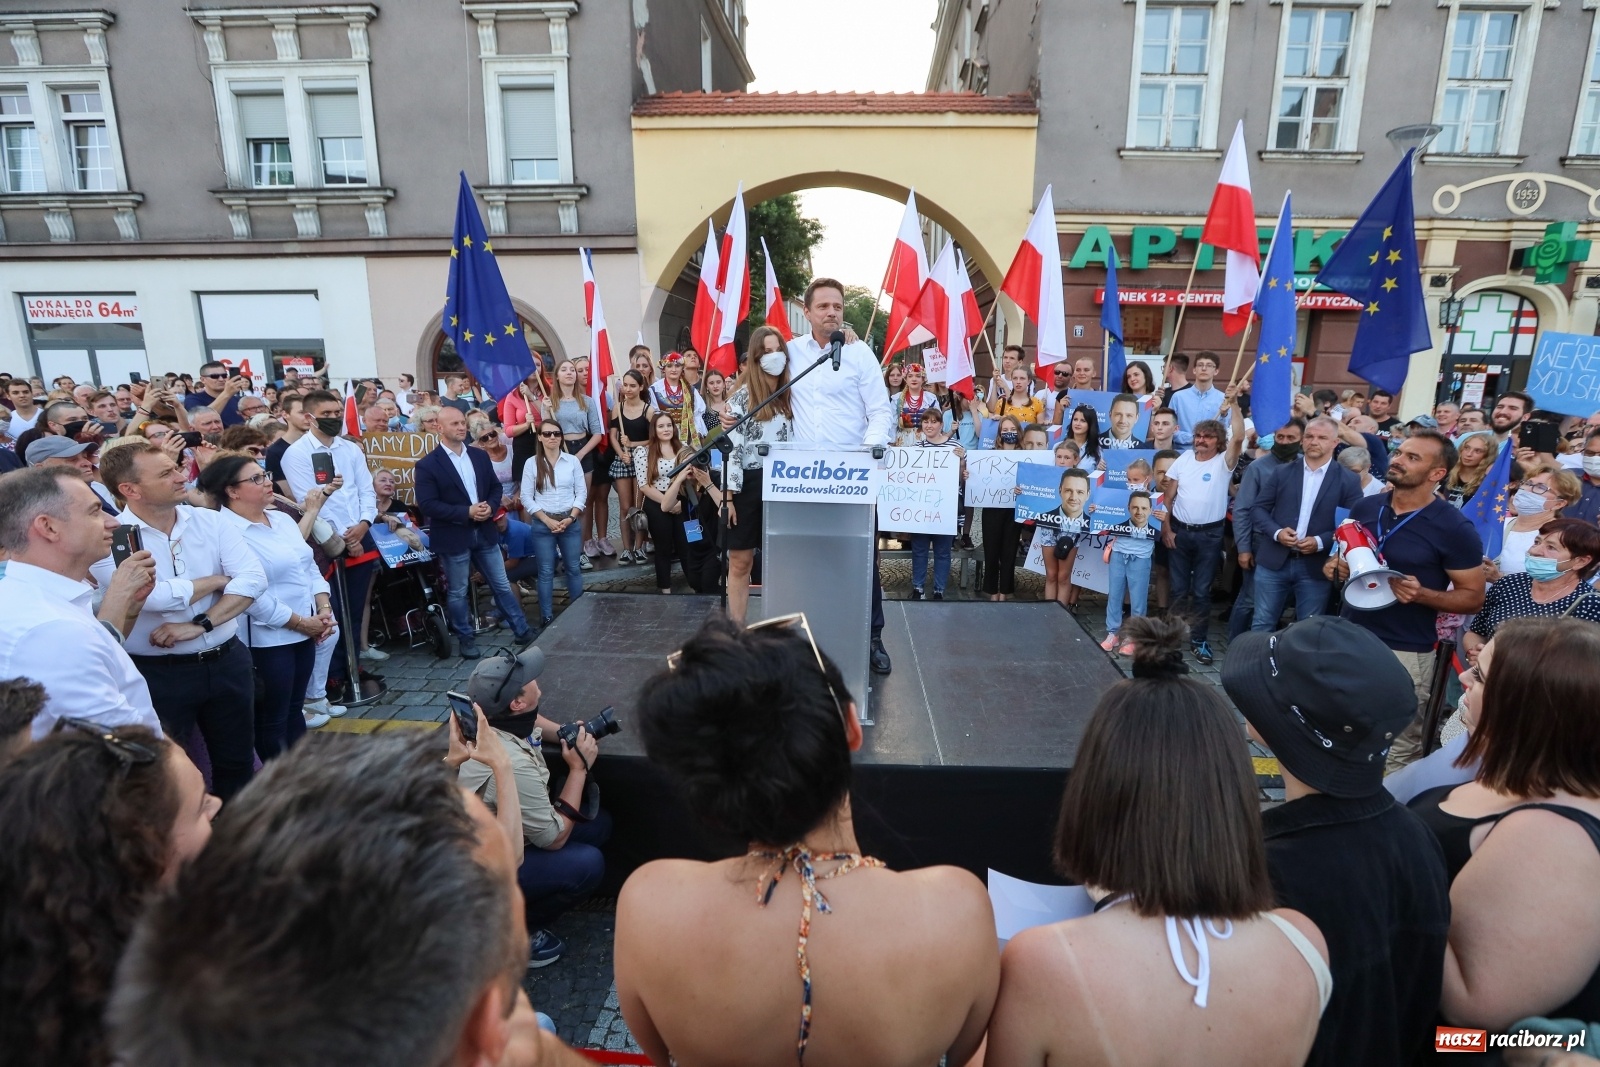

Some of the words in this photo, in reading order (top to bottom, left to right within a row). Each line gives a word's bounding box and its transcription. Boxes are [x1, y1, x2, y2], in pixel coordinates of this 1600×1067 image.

[1516, 189, 1538, 200] 1953
[28, 300, 70, 309] LOKAL
[75, 300, 92, 308] DO
[1151, 293, 1167, 303] 12
[29, 309, 94, 319] WYNAJĘCIA
[1532, 369, 1573, 396] YOU
[1573, 374, 1600, 400] SH
[771, 460, 870, 481] Racibórz
[971, 456, 1033, 476] TRZ
[887, 471, 937, 484] KOCHA
[771, 484, 868, 496] Trzaskowski2020
[877, 485, 944, 508] ARDZIEJ
[890, 507, 942, 523] GOCHA
[1093, 523, 1155, 536] TRZASKOWSKI
